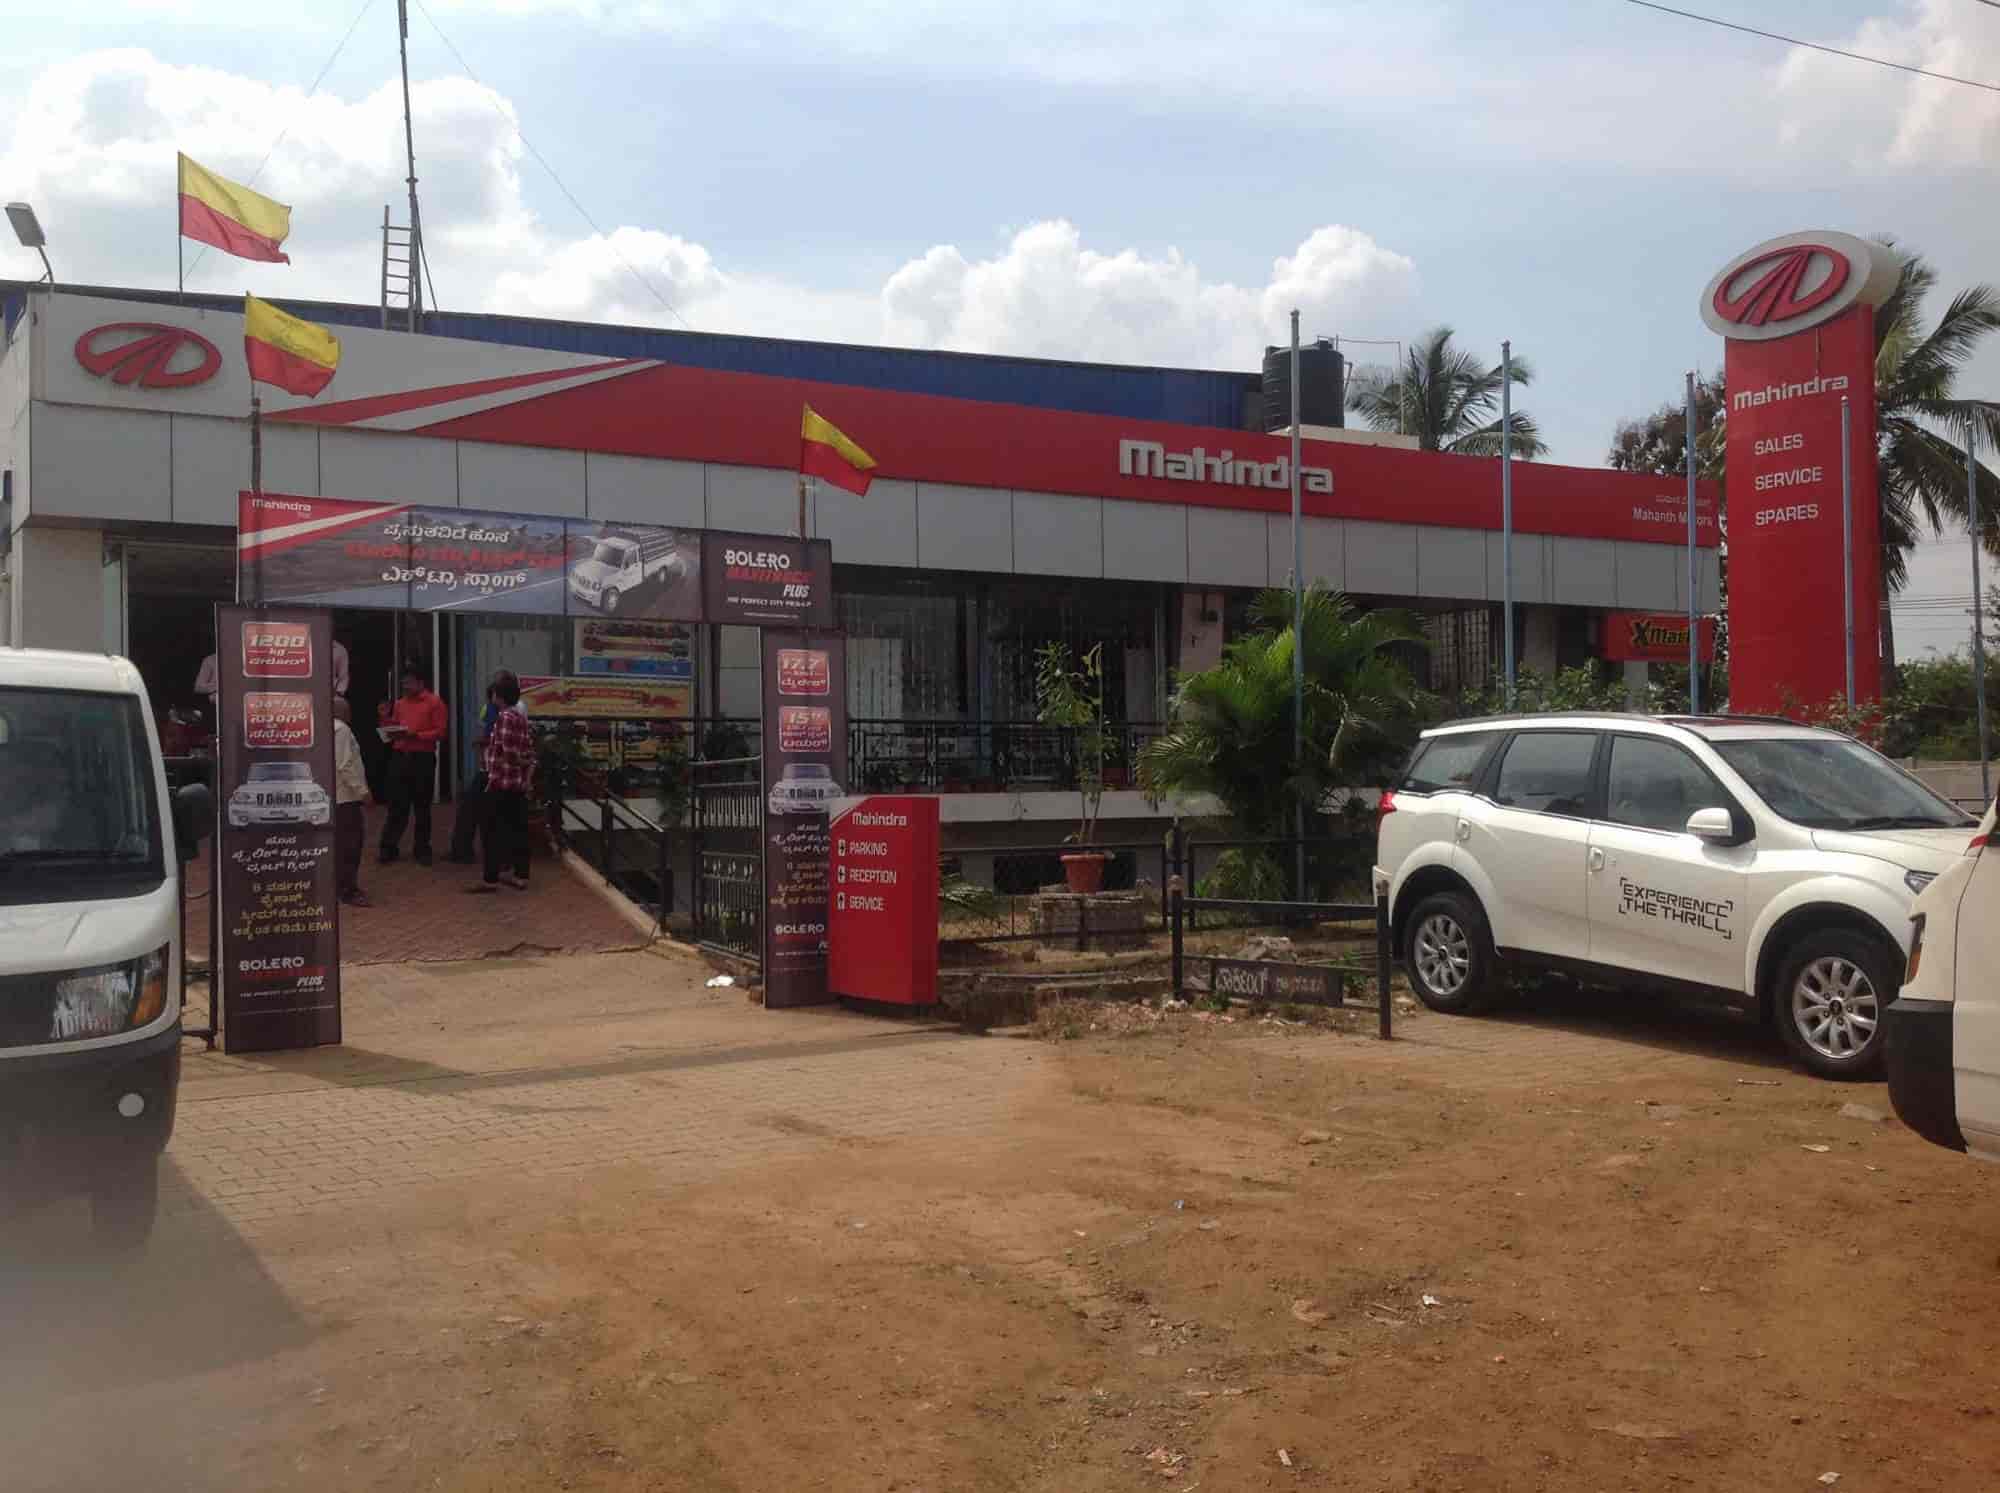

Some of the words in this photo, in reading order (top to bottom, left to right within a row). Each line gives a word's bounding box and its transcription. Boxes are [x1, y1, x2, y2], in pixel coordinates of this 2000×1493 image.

[1734, 375, 1848, 411] Mahindra
[1755, 433, 1804, 455] SALES
[1755, 466, 1823, 491] SERVICE
[252, 498, 312, 512] Mahindra
[1755, 503, 1819, 526] SPARES
[724, 549, 791, 571] BOLERO
[783, 583, 810, 598] PLUS
[250, 634, 305, 648] 1200
[852, 811, 908, 827] Mahindra
[850, 841, 888, 857] PARKING
[849, 868, 897, 885] RECEPTION
[849, 895, 885, 912] SERVICE
[1623, 896, 1657, 916] THE
[1661, 905, 1727, 933] THRILL
[774, 923, 825, 936] BOLERO
[239, 956, 305, 972] BOLERO
